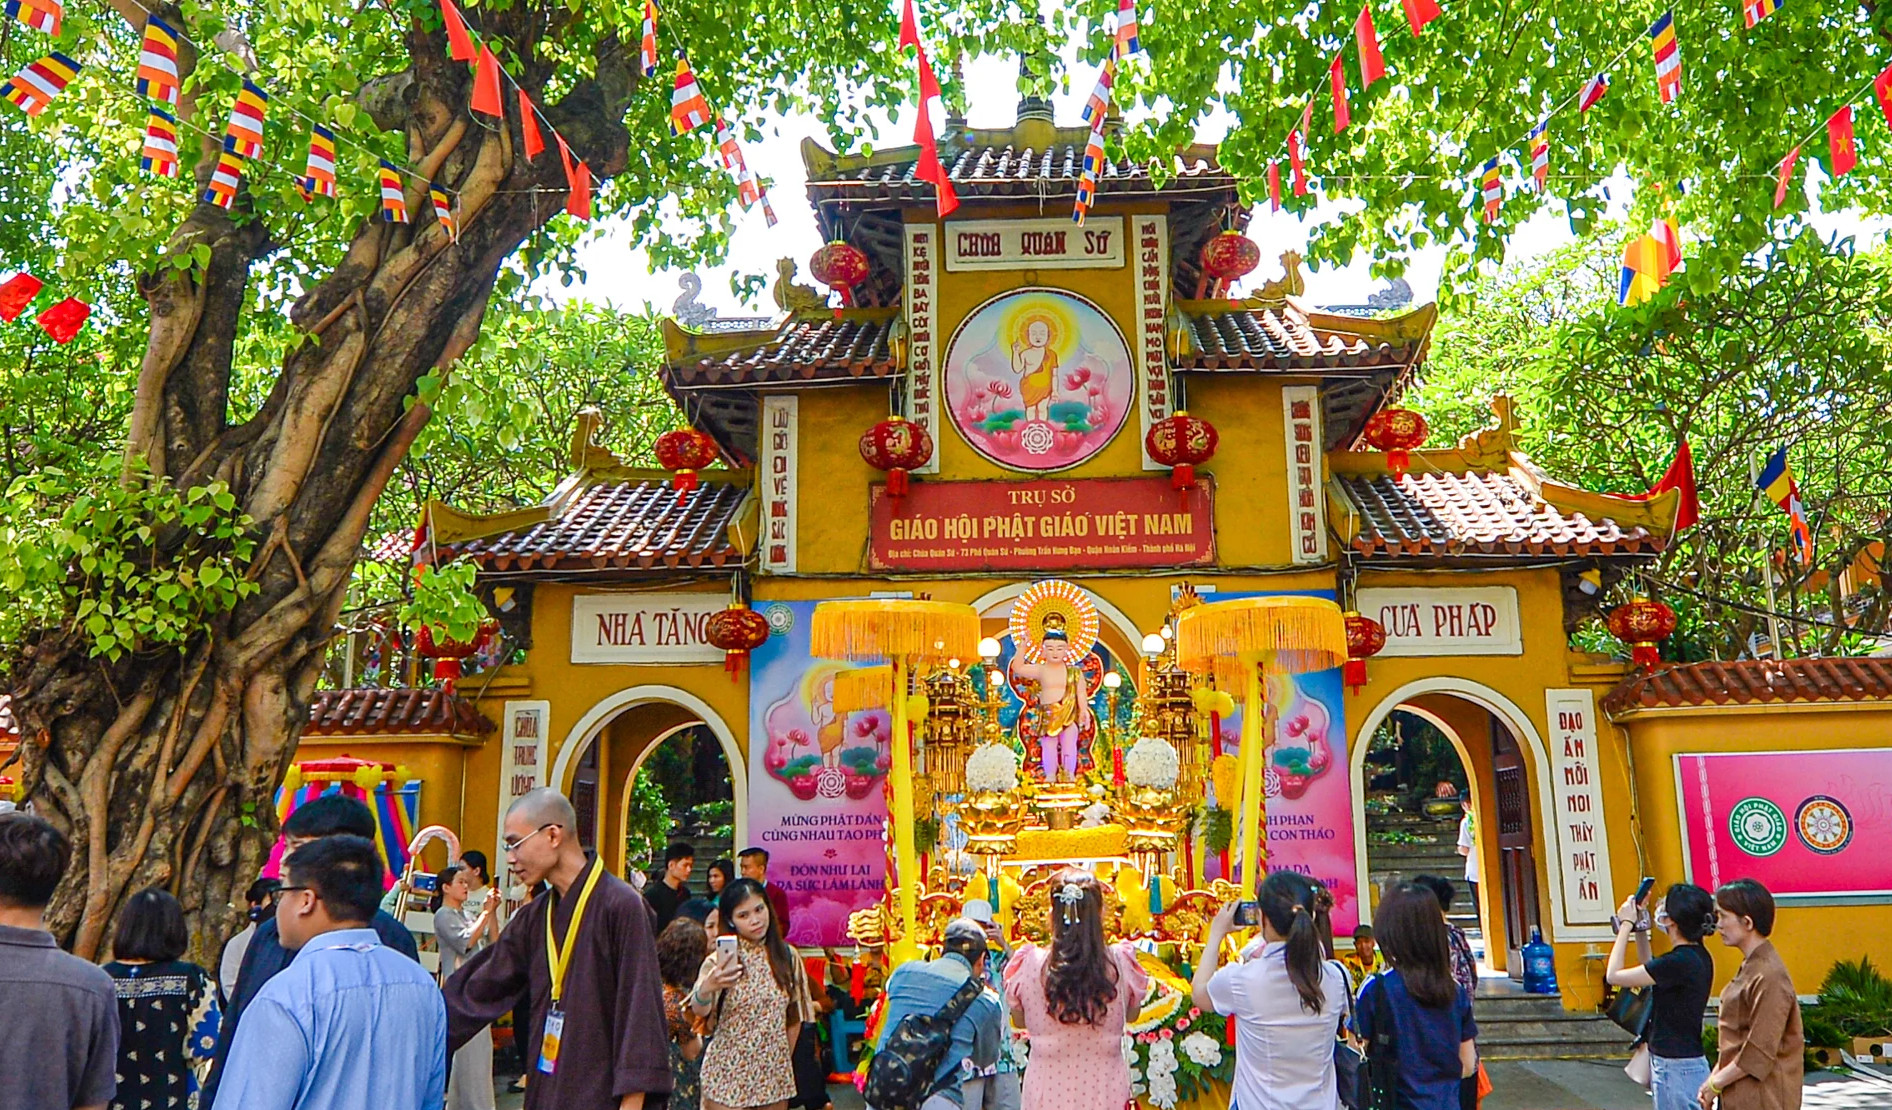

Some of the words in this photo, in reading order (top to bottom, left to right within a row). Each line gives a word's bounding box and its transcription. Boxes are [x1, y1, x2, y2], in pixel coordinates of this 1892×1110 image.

[957, 231, 1002, 257] CHÙA
[1021, 231, 1067, 256] QUÁN
[913, 288, 928, 299] BA
[1008, 490, 1046, 508] TRỤ
[1051, 484, 1076, 504] SỞ
[890, 513, 939, 541] GIÁO
[944, 513, 979, 544] HỘI
[983, 512, 1036, 543] PHẬT
[1040, 511, 1089, 538] GIÁO
[1095, 510, 1138, 540] VIỆT
[1144, 513, 1193, 536] NAM
[961, 547, 969, 557] 73
[596, 610, 647, 646] NHÀ
[1379, 603, 1422, 638] CỬA
[1432, 602, 1497, 637] PHÁP
[1558, 712, 1583, 733] ĐẠO
[780, 813, 818, 827] MỪNG
[820, 813, 854, 828] PHẬT
[762, 828, 798, 842] CÙNG
[800, 830, 835, 842] NHAU
[837, 829, 864, 843] TẠO
[1269, 829, 1297, 841] CON
[820, 864, 849, 876] NHƯ
[851, 864, 871, 876] LAI
